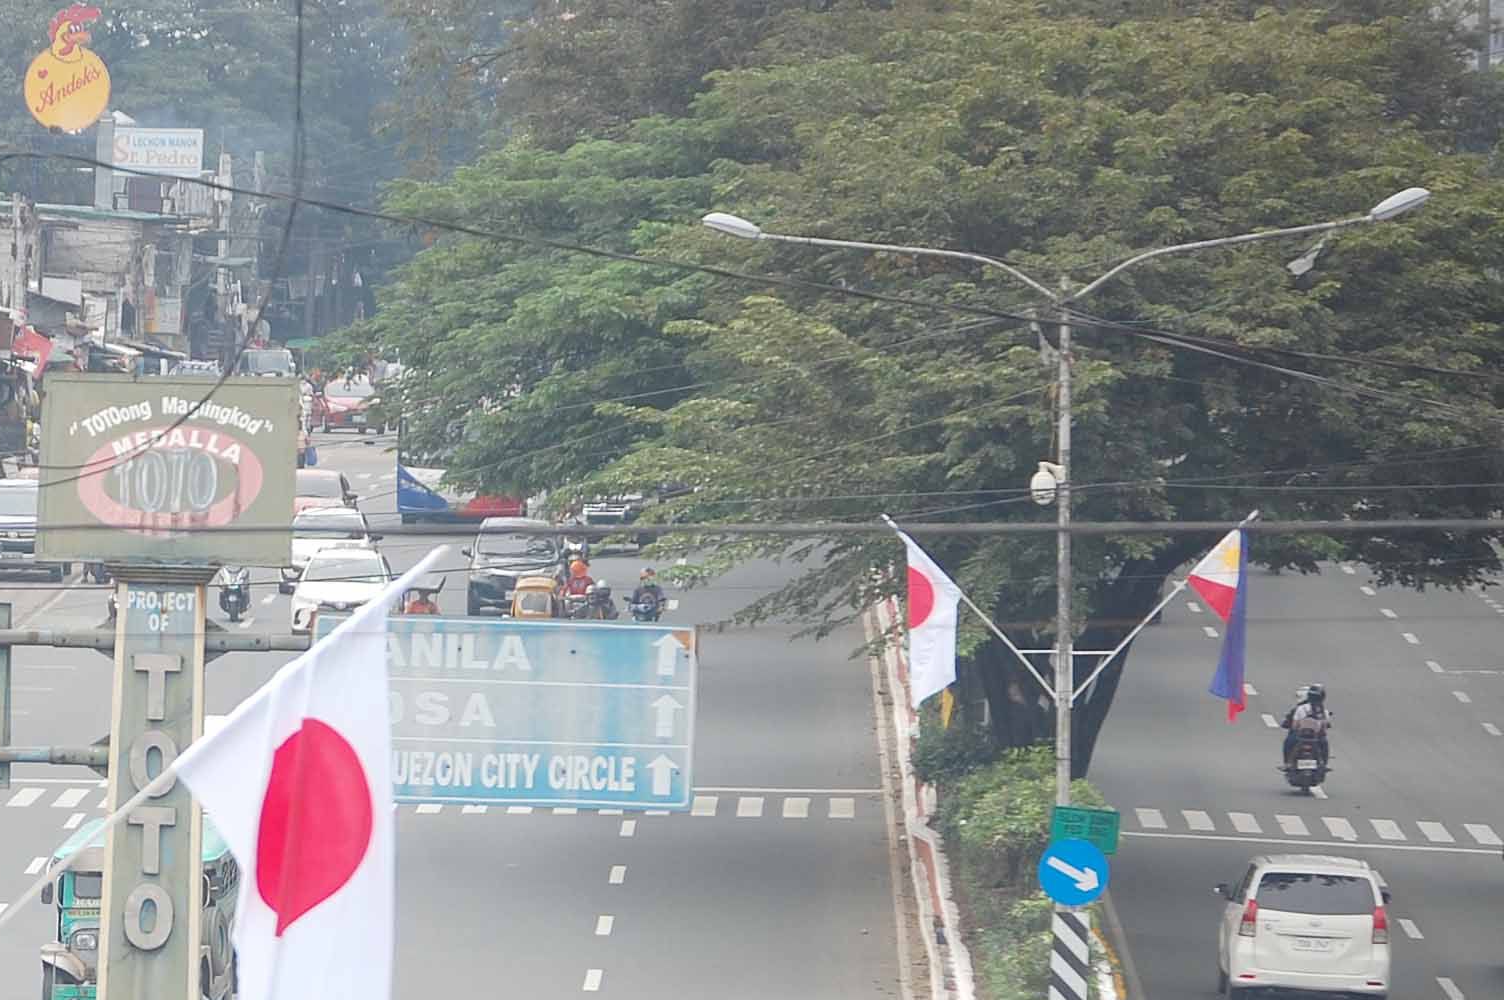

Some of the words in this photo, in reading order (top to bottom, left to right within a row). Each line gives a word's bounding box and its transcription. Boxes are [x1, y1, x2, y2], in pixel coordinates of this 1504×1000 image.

[112, 429, 242, 465] MEDALLA
[113, 449, 218, 513] TOTO
[127, 591, 196, 613] PROJECT
[148, 612, 169, 632] OF
[388, 632, 533, 671] ANILA
[393, 750, 473, 787] UEZON
[481, 753, 541, 790] CITY
[548, 755, 636, 792] CIRCLE
[123, 653, 184, 951] TOTO
